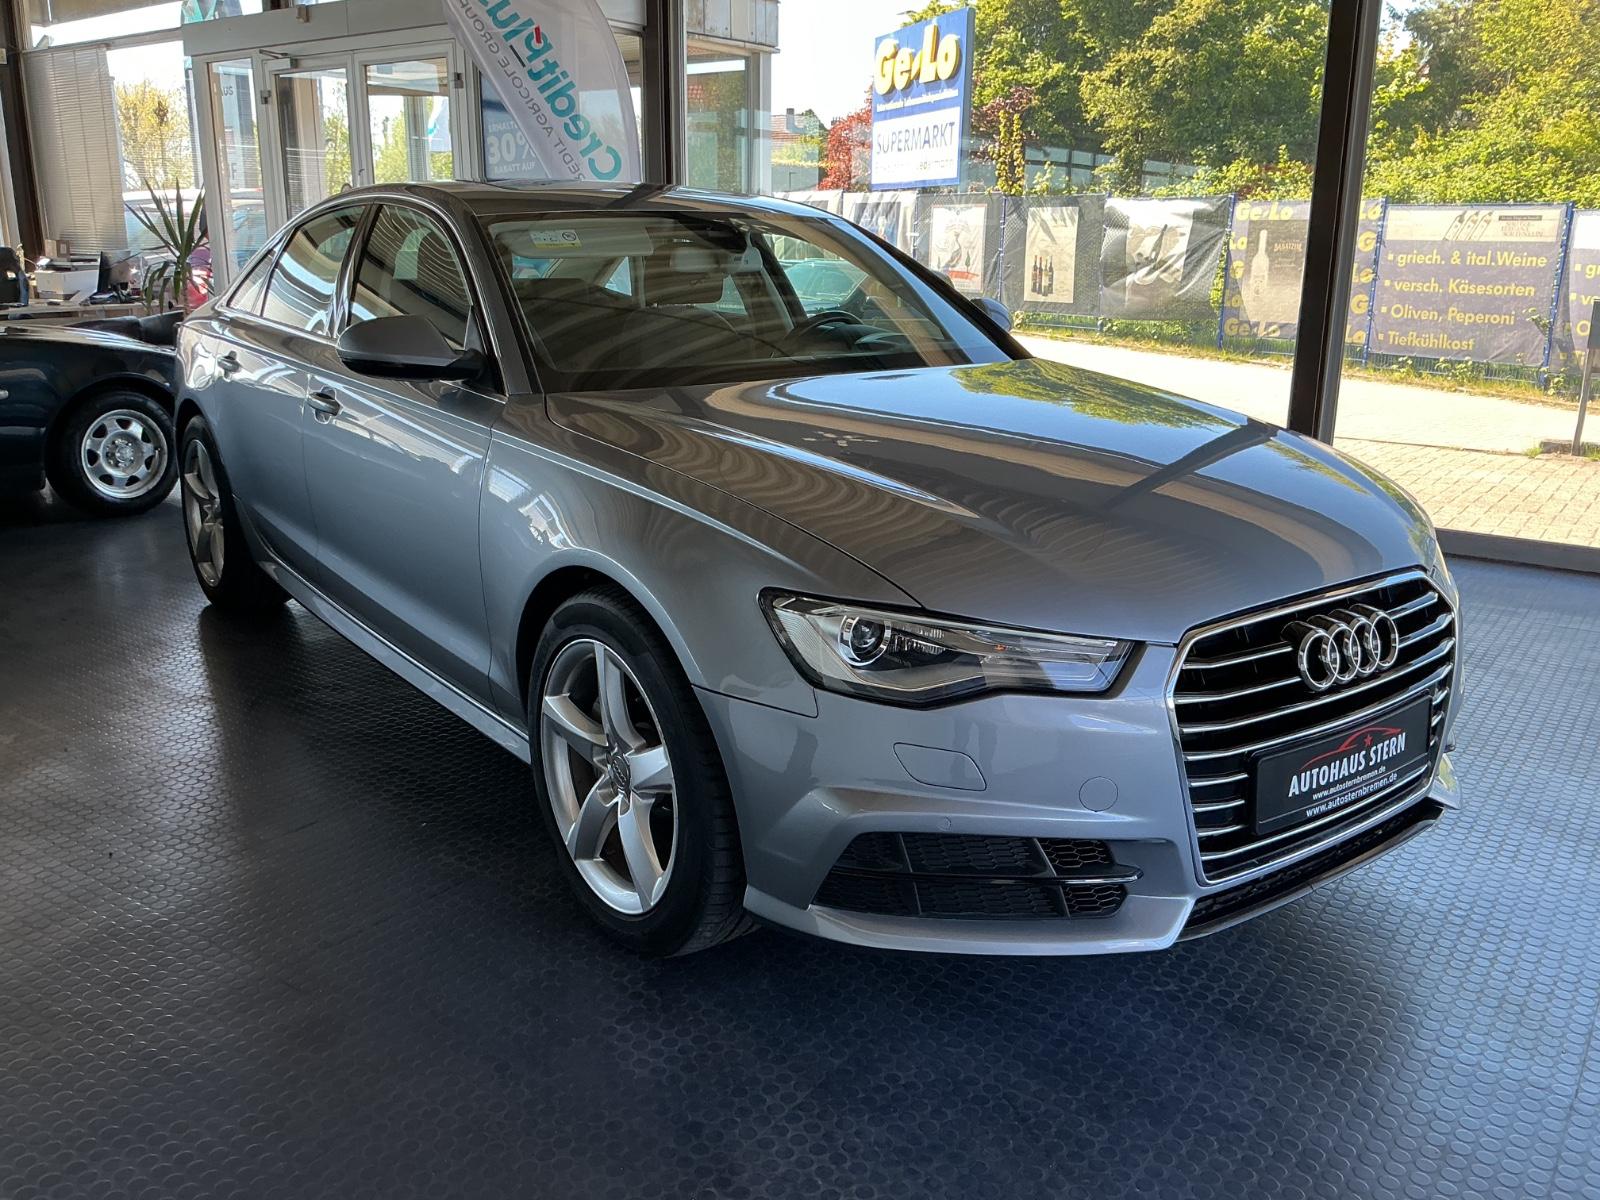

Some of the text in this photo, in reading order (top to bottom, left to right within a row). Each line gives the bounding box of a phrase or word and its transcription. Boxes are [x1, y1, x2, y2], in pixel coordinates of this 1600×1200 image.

[876, 121, 956, 155] SUPERMARKT
[1397, 248, 1445, 267] griech.
[1450, 250, 1462, 265] &
[1394, 278, 1536, 297] versch. Käsesorten
[1391, 304, 1516, 326] Oliven, Peperoni
[1388, 331, 1476, 351] Tiefkühlkost
[1288, 732, 1406, 798] AUTOHAUS STERN
[1306, 772, 1398, 817] www.autosternbremen.de
[1312, 765, 1386, 800] www.autosternbremen.de
